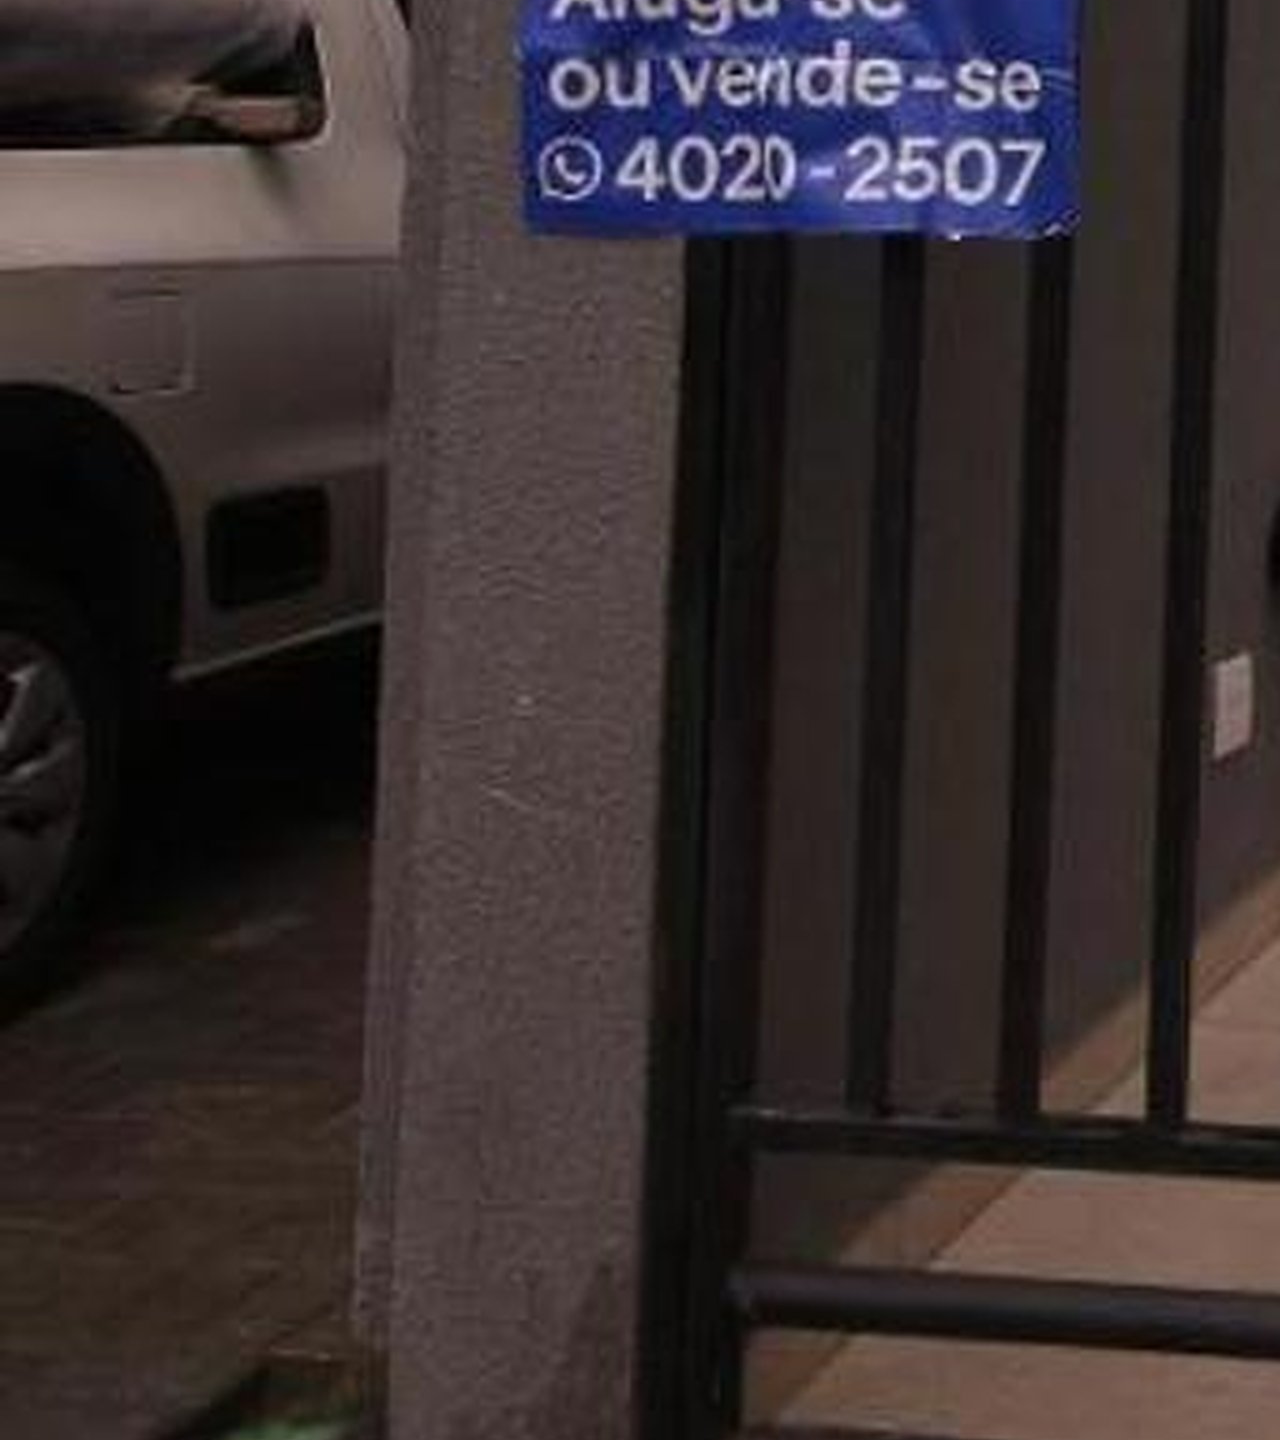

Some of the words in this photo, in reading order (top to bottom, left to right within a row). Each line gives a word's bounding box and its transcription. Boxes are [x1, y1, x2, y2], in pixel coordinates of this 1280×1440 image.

[548, 58, 651, 110] ou
[668, 39, 1044, 111] vende-se
[615, 134, 1049, 207] 4020-2507
